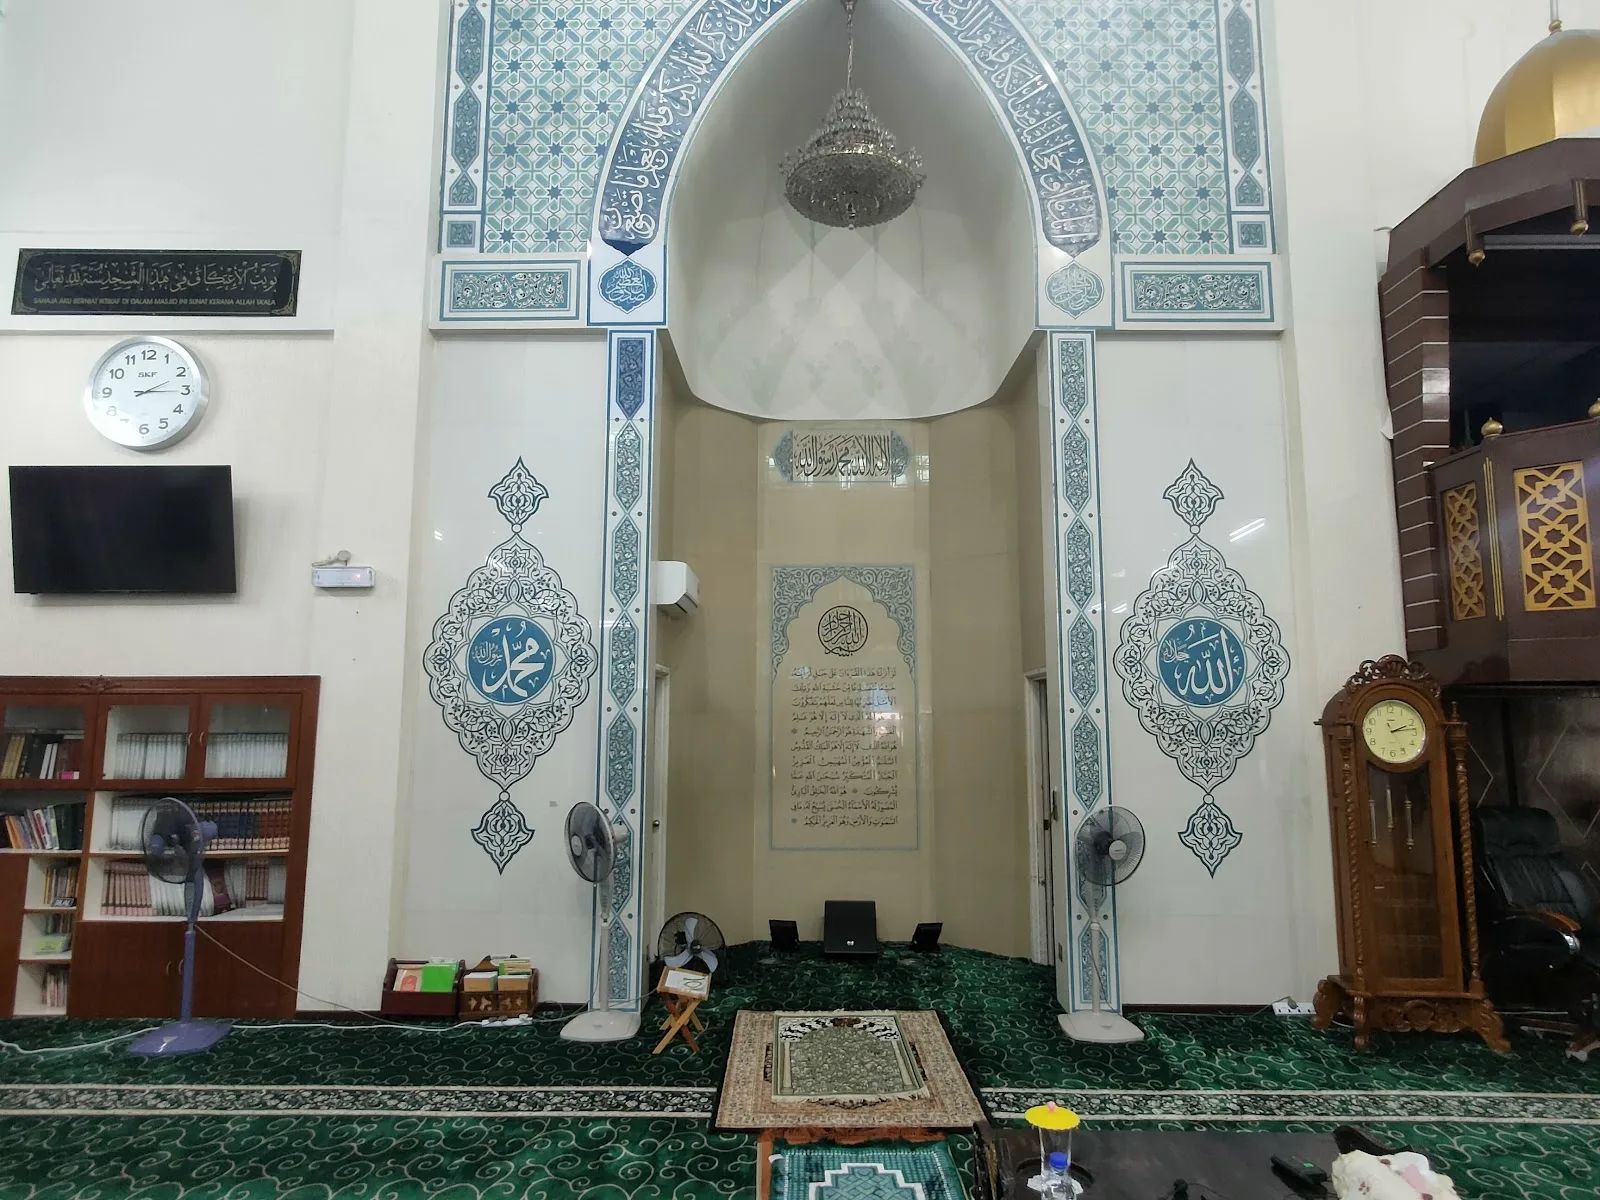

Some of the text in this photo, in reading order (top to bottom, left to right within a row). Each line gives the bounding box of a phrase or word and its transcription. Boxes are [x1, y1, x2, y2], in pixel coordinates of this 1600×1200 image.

[125, 354, 136, 365] 11
[141, 349, 157, 360] 12
[164, 353, 170, 364] 1
[109, 368, 125, 379] 10
[176, 366, 186, 377] 2
[102, 387, 112, 398] 9
[180, 385, 191, 395] 3
[106, 405, 117, 417] 8
[173, 403, 184, 414] 4
[138, 423, 150, 435] 6
[158, 418, 169, 429] 5
